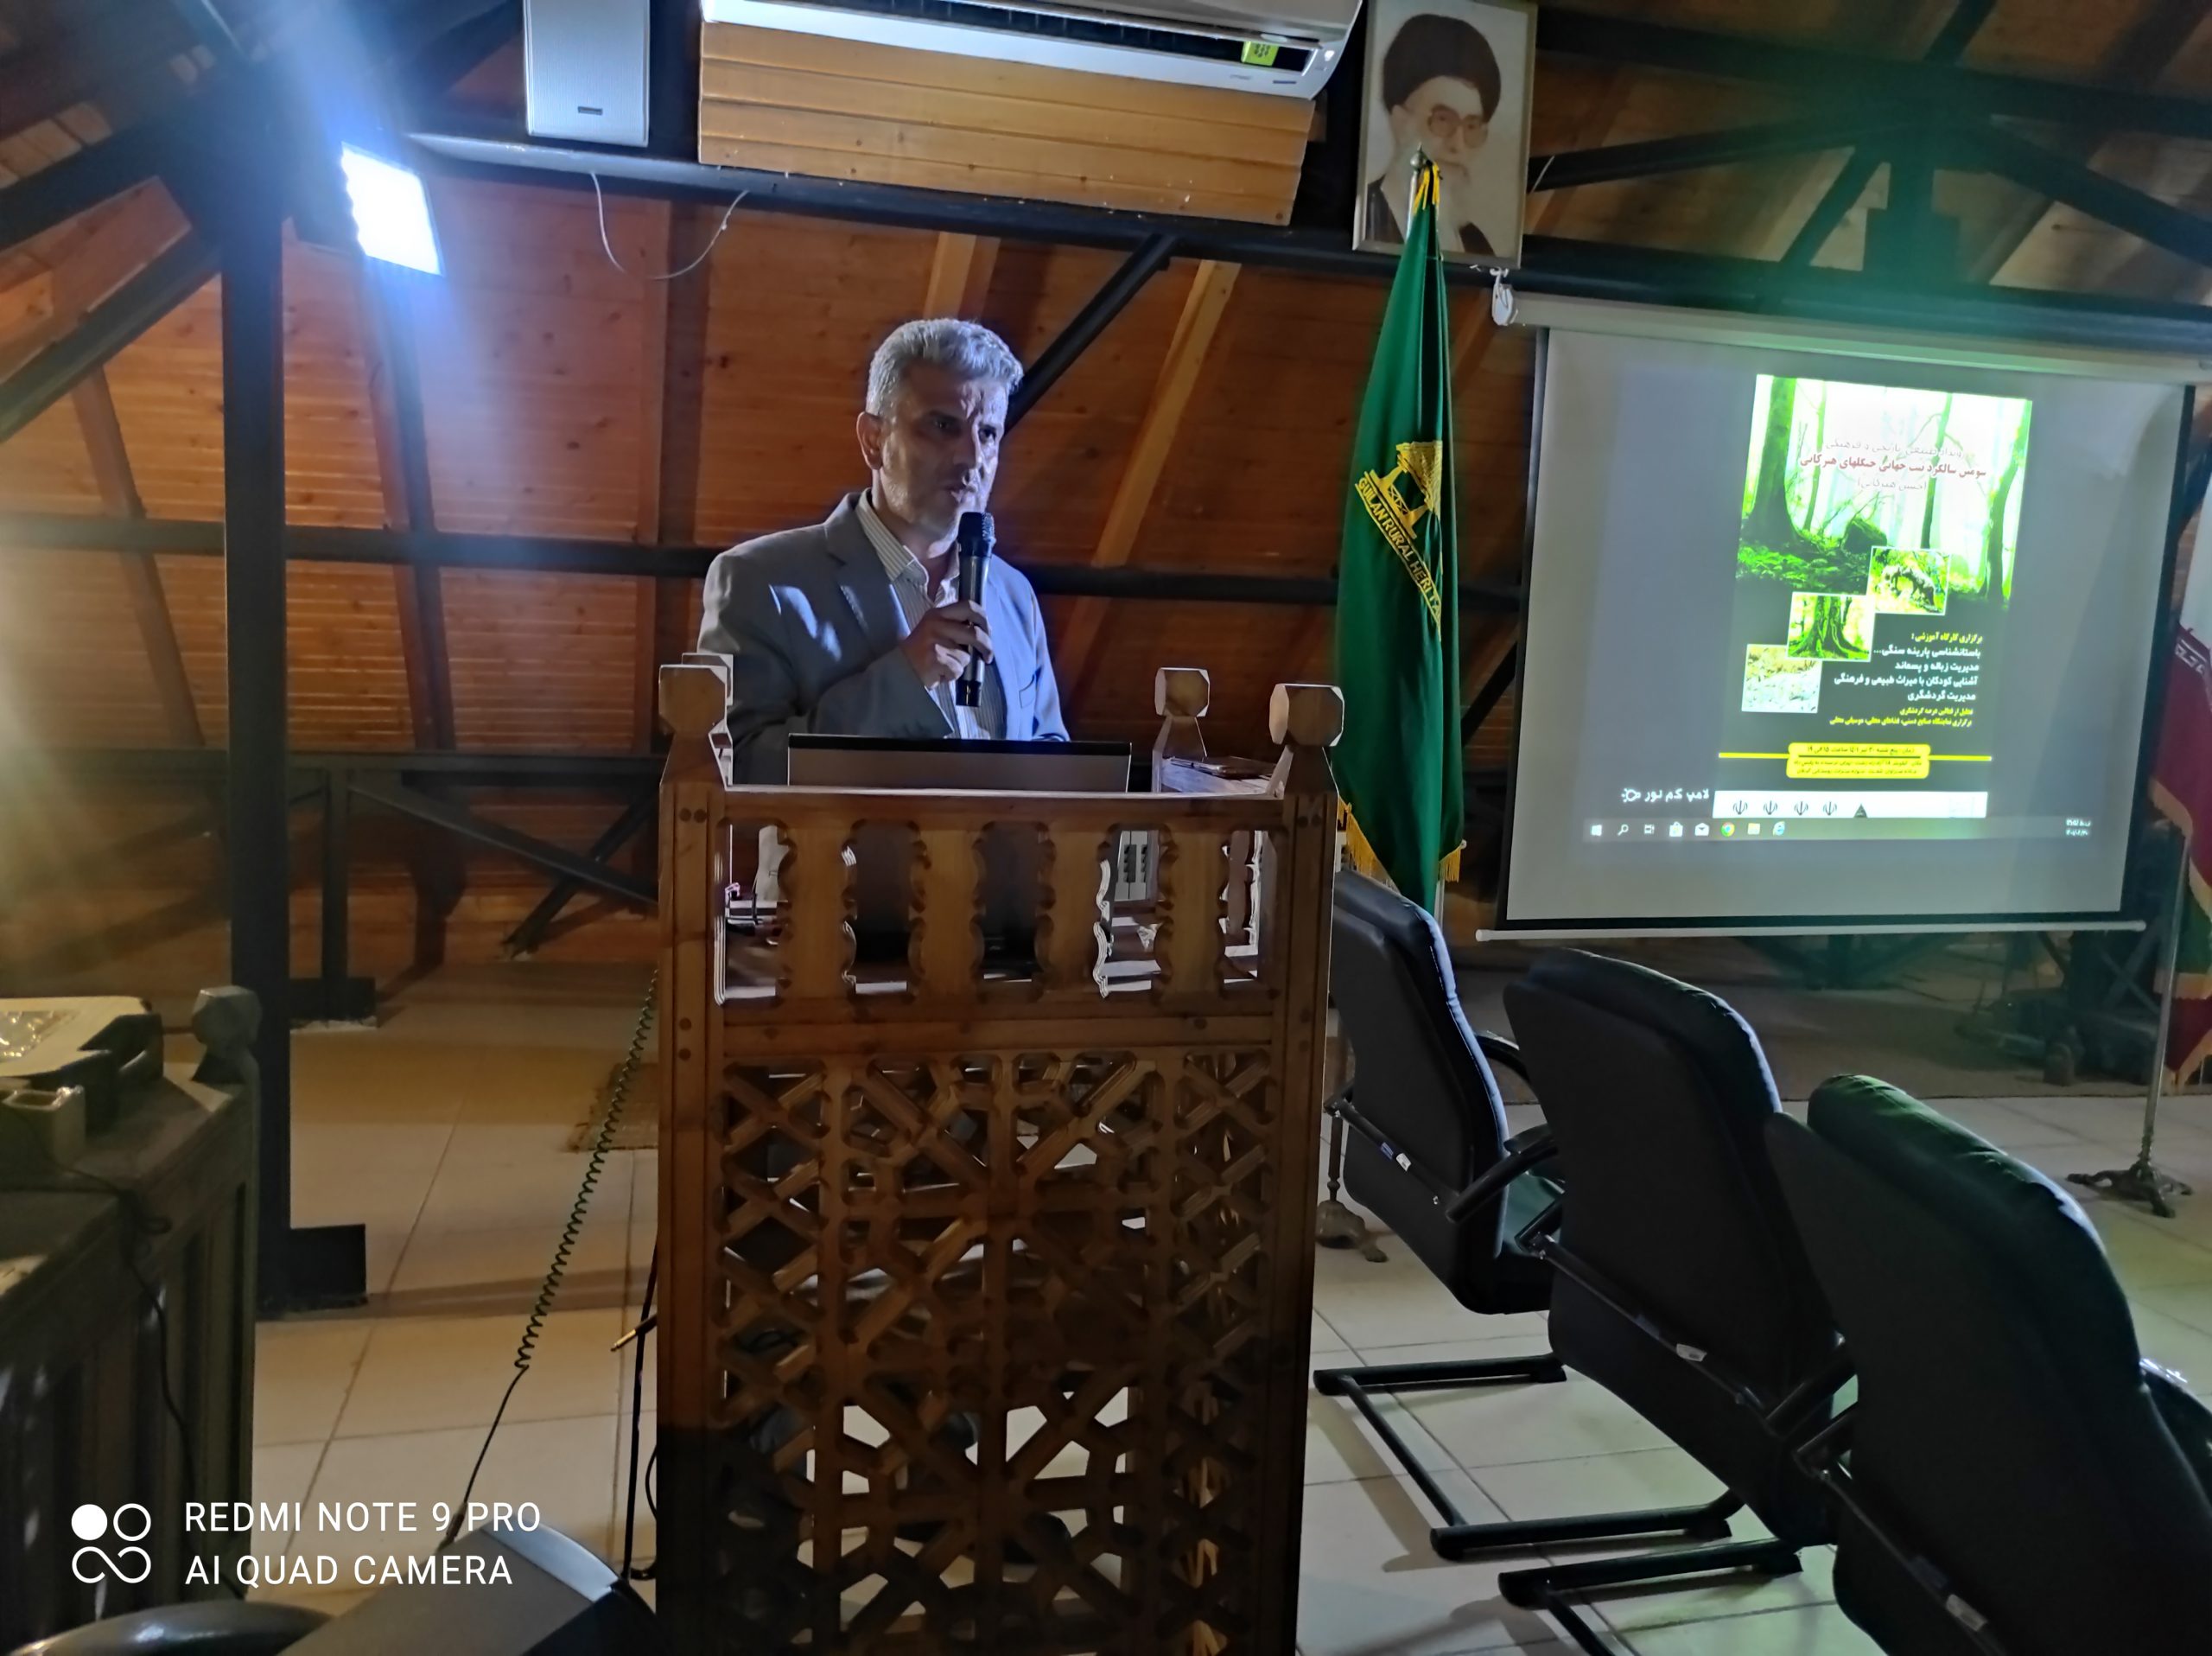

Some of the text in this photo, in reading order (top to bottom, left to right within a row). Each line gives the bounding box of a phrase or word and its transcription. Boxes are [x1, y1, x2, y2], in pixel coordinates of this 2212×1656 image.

[1357, 476, 1441, 619] GUILAN RURAL HERITA
[1907, 646, 1930, 659] پارینه
[1895, 660, 1980, 673] مدیریت زباله و پسماند
[1834, 672, 1979, 687] آشنایی کودکان با میراث طبیعی و فرهنگی
[1907, 689, 1976, 703] مدیریت گردشگری
[1644, 788, 1710, 802] لامپ کم نور
